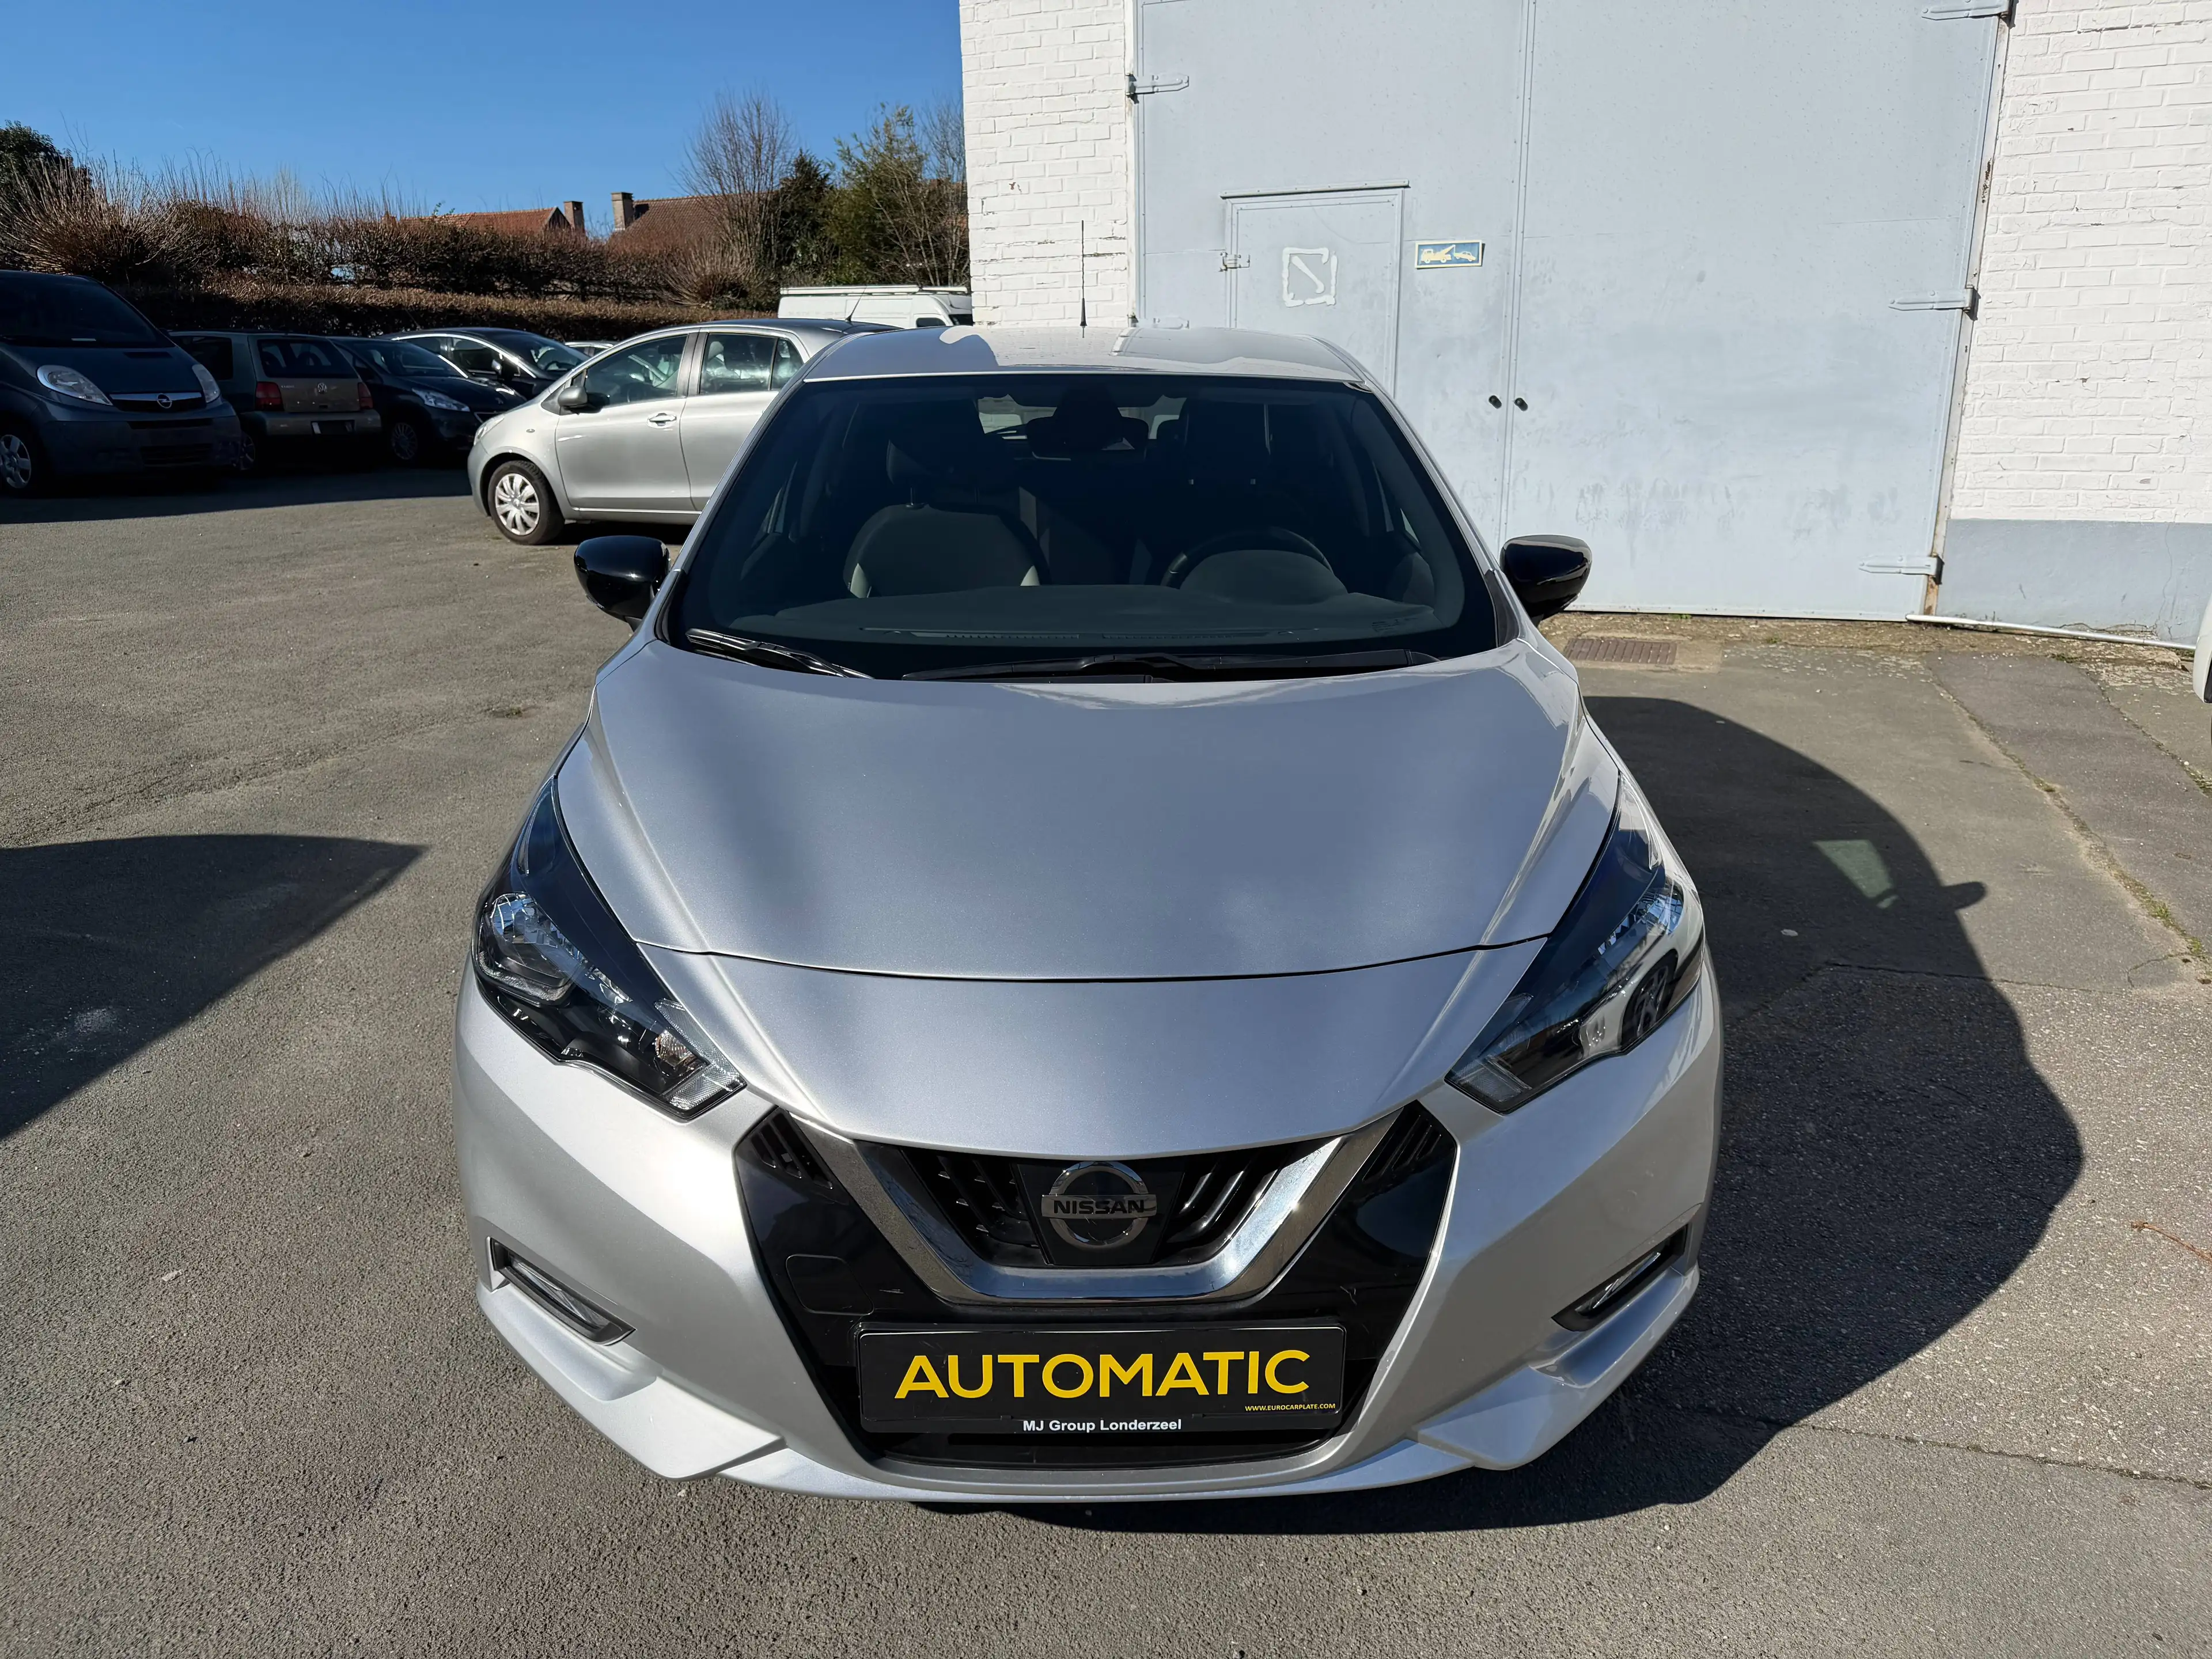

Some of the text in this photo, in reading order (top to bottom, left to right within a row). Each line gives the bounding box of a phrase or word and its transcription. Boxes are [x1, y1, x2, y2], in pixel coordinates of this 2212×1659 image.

[1054, 1199, 1145, 1214] NISSAN
[894, 1349, 1310, 1399] AUTOMATIC
[1245, 1403, 1336, 1411] WWW.EUROCARPLATE.COM
[1023, 1419, 1181, 1433] MJ Group Londerzeel
